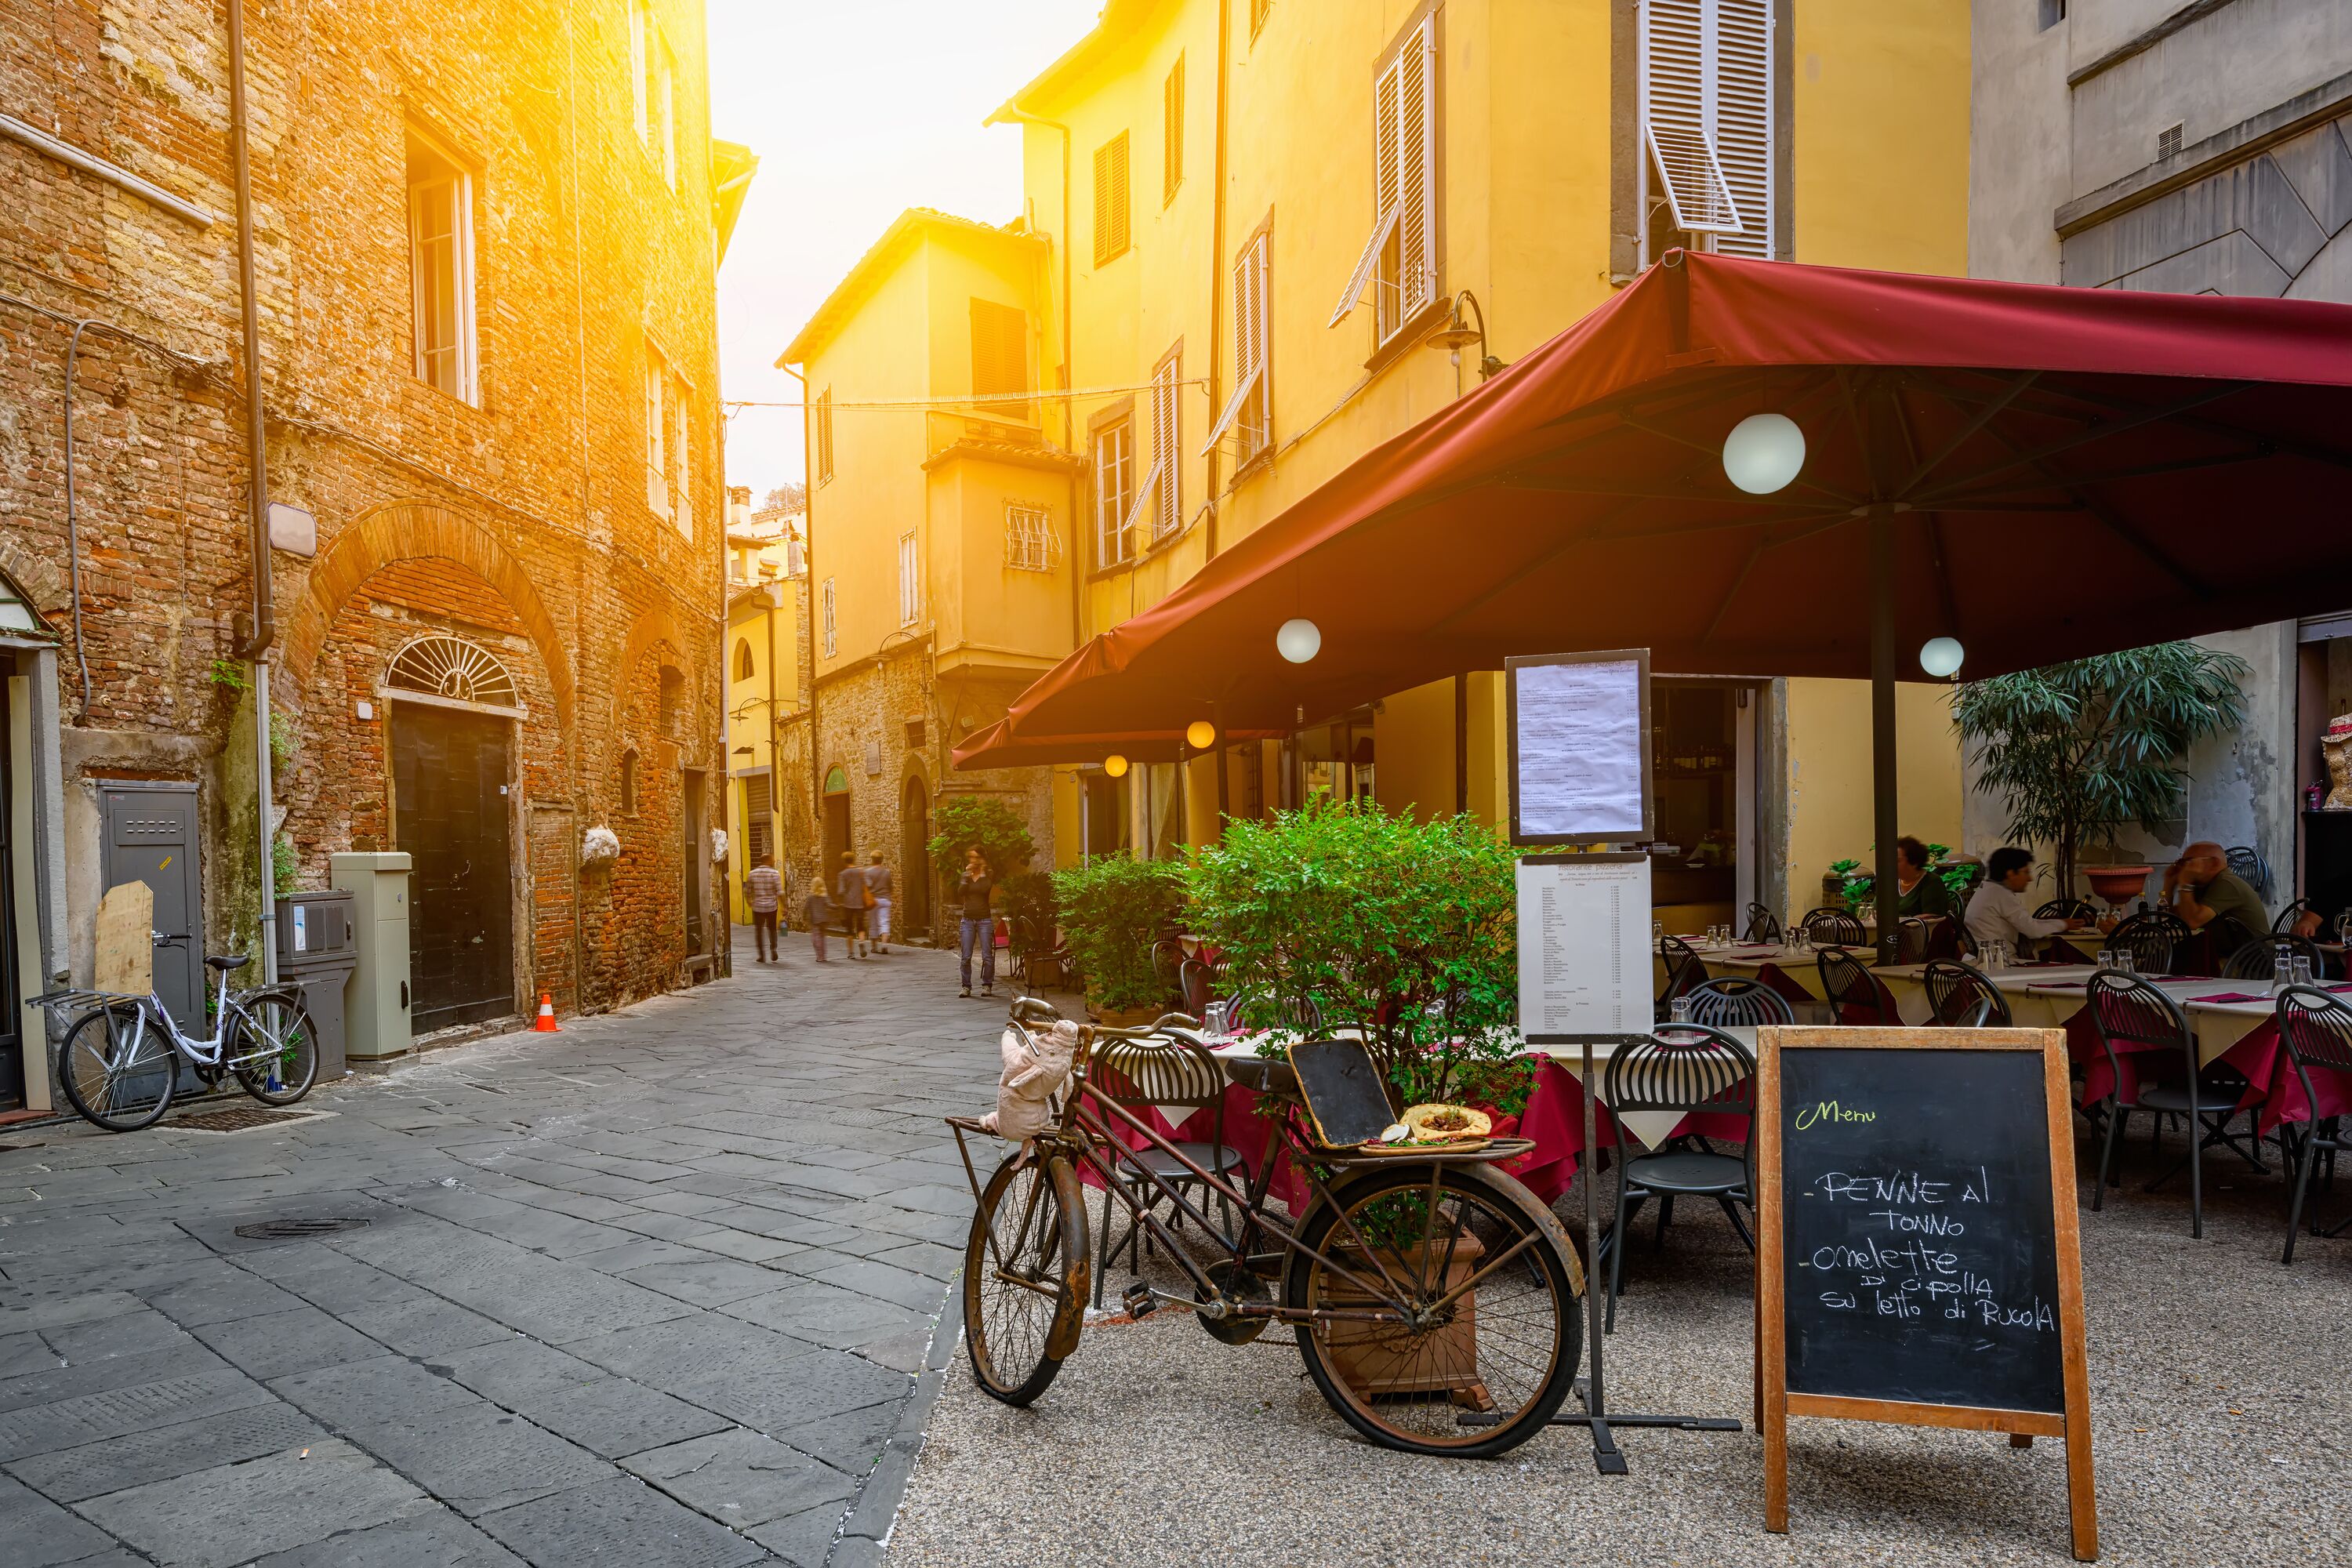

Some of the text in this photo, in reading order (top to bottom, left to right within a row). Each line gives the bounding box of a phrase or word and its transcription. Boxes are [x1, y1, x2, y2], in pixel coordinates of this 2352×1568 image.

[1795, 1100, 1876, 1131] Menu
[1815, 1169, 1951, 1204] PENNE
[1876, 1290, 1920, 1318] letto
[1944, 1298, 1966, 1319] di
